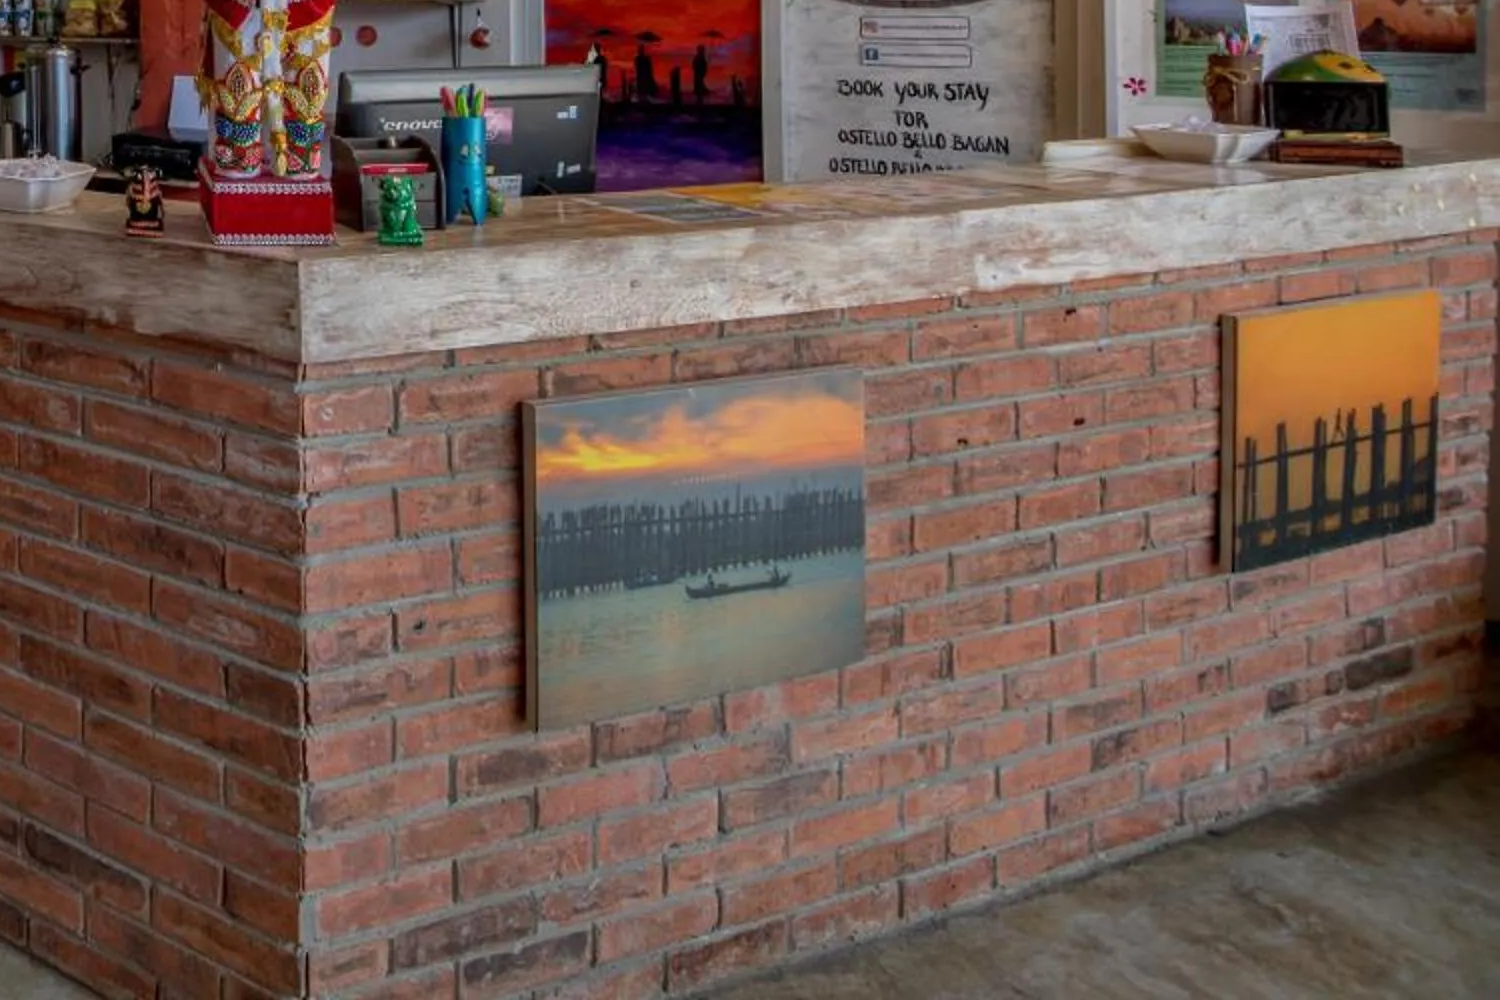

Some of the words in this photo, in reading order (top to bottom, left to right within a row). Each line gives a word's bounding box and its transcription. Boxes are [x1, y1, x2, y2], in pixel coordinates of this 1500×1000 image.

[836, 79, 884, 97] BOOK
[944, 80, 990, 111] STAY
[837, 129, 897, 147] OSTELLO
[903, 130, 947, 149] BELLO
[952, 134, 1010, 156] BAGAN
[829, 157, 888, 175] OSTELLO
